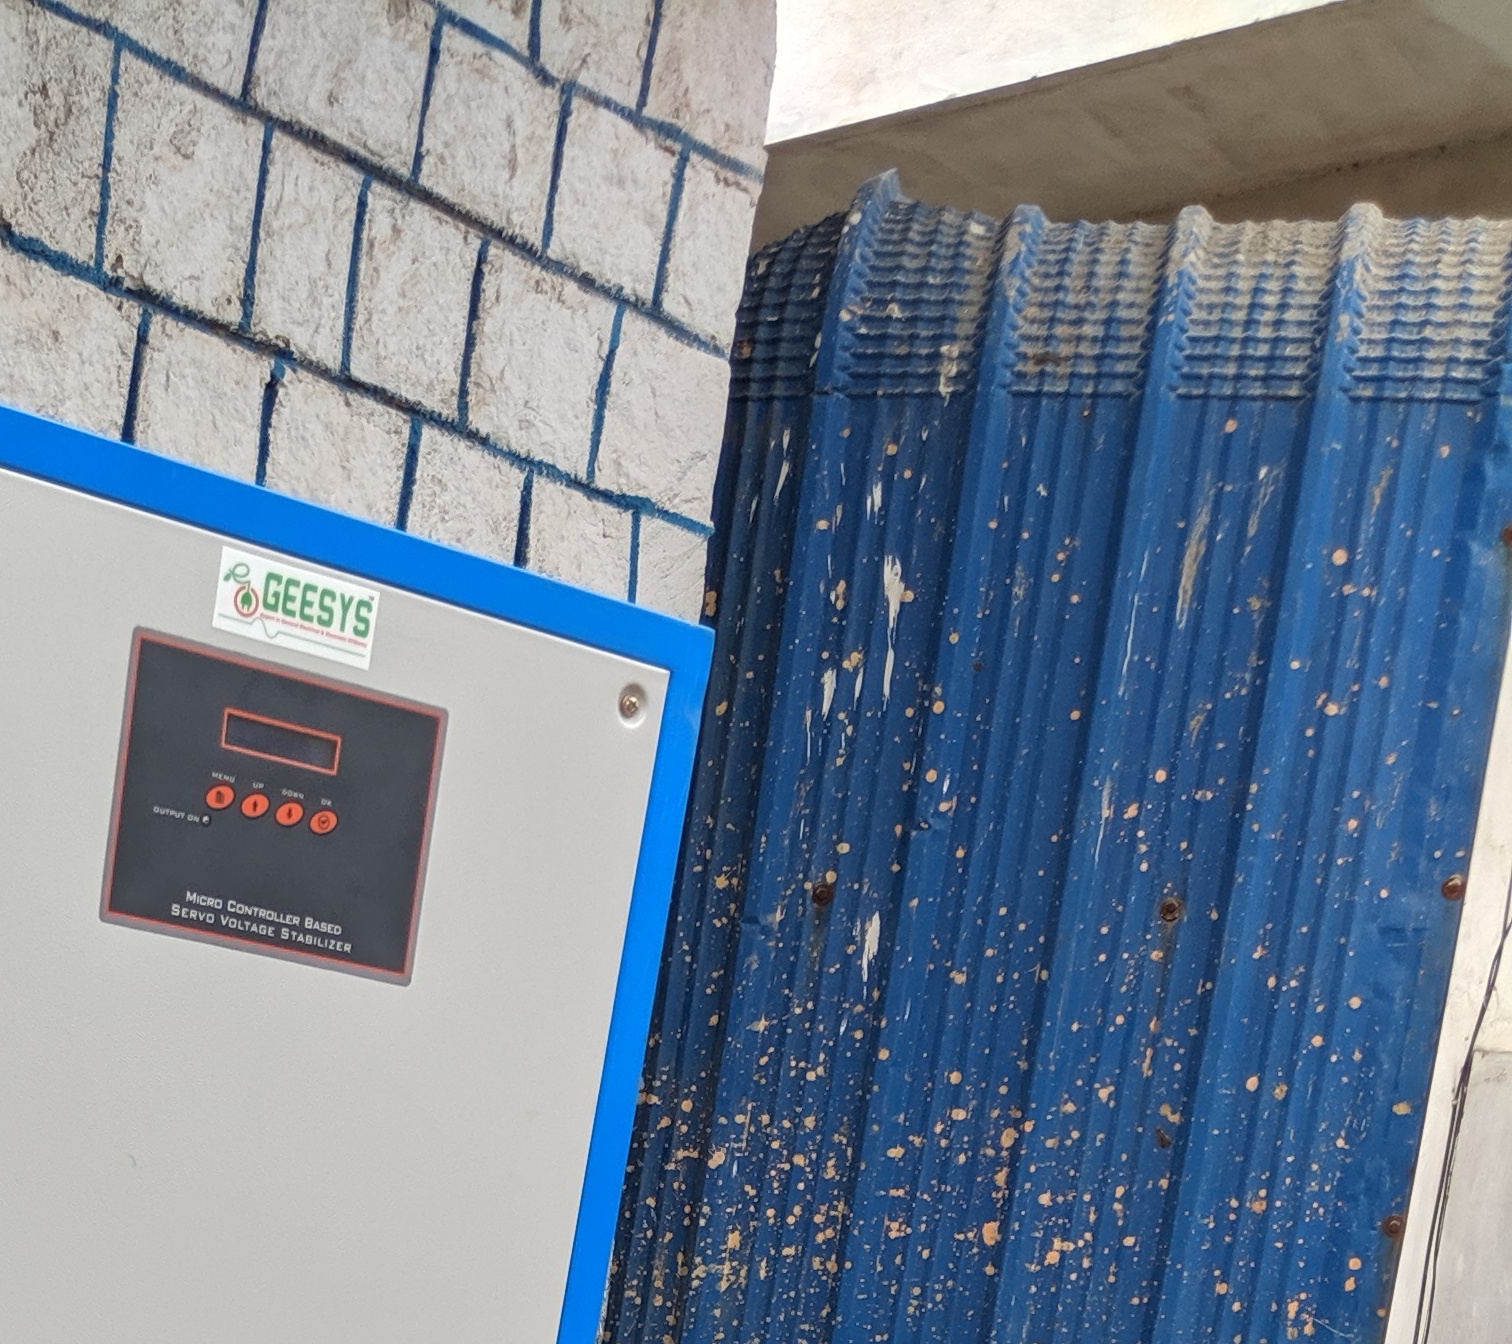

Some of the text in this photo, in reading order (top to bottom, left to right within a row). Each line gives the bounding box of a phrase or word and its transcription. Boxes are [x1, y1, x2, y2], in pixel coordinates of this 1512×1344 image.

[262, 571, 373, 639] GEESYS
[211, 771, 236, 783] MENU
[252, 781, 265, 790] UP
[320, 798, 332, 807] OK
[153, 806, 200, 823] OUTPUT ON
